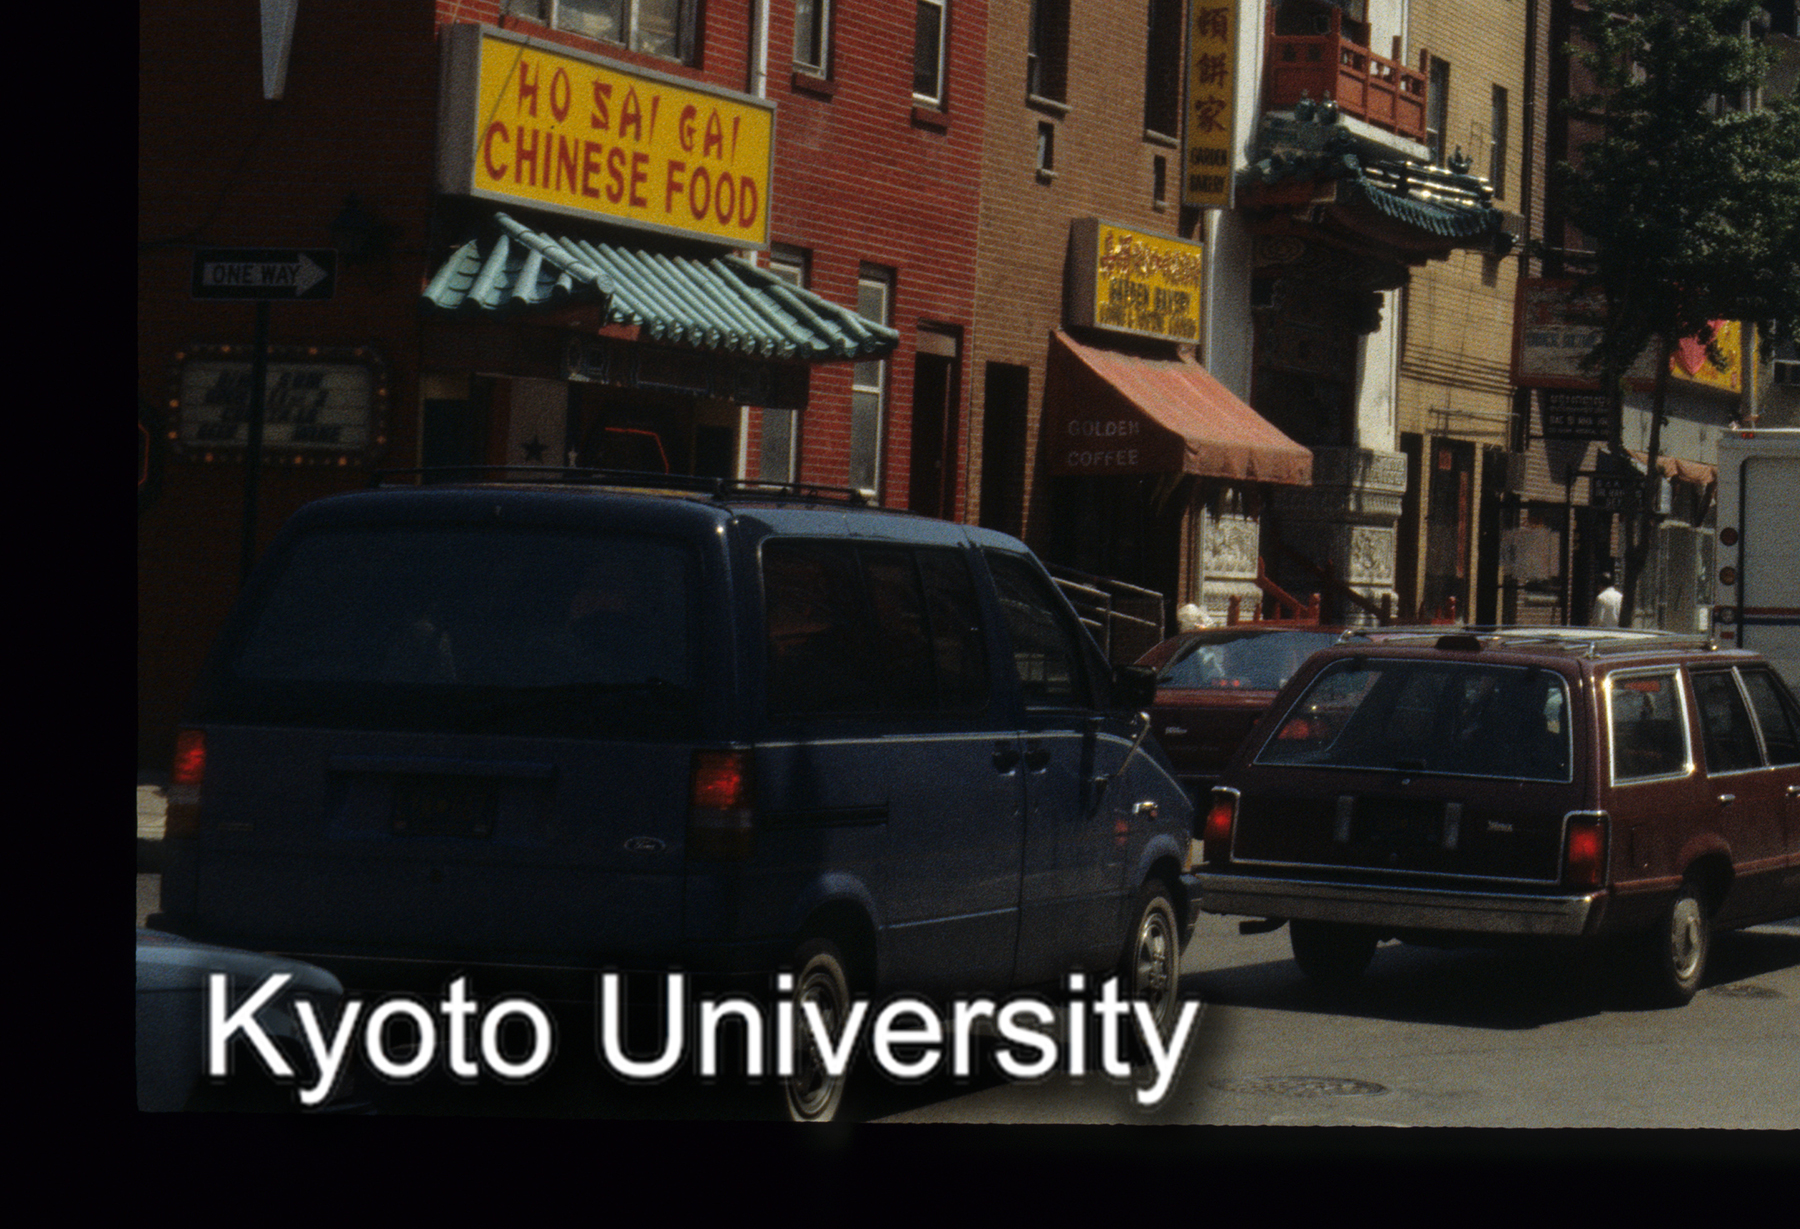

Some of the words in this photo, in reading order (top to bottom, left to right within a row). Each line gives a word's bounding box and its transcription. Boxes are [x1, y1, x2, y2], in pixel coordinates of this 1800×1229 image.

[517, 59, 571, 124] HO
[590, 76, 662, 143] SAI
[678, 103, 742, 167] GAI
[483, 119, 650, 209] CHINESE
[664, 157, 759, 229] FOOD
[212, 264, 254, 285] ONE
[260, 264, 300, 285] WAY
[1068, 449, 1140, 467] COFFEE
